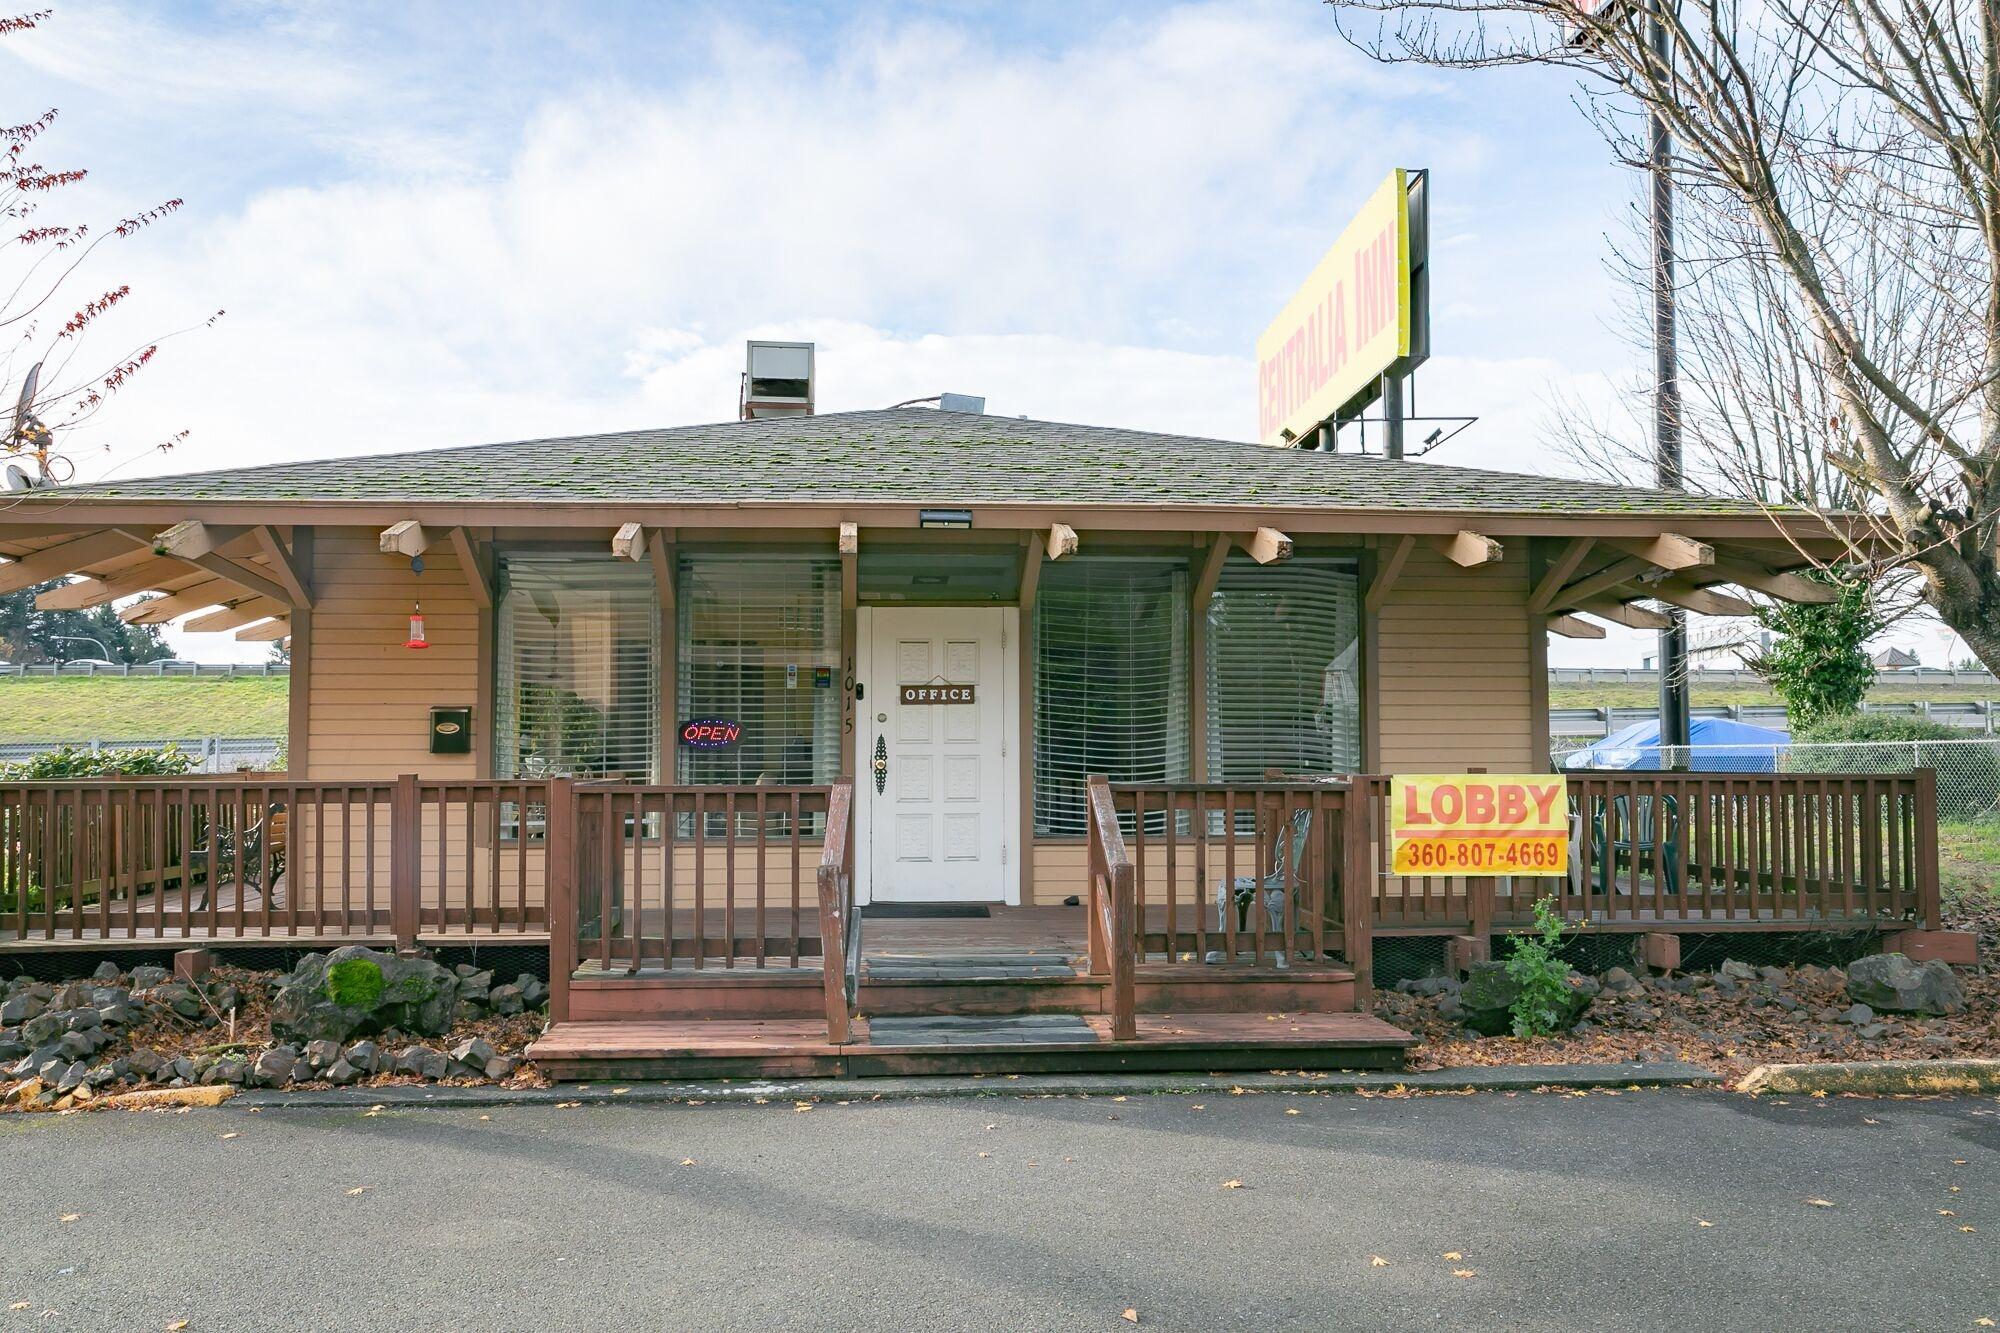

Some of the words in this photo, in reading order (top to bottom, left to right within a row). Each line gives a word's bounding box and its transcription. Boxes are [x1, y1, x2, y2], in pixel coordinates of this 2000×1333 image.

[1259, 280, 1347, 442] CENTRALIA
[1355, 219, 1396, 353] INN
[844, 656, 854, 734] 1015
[905, 689, 971, 700] OFFICE
[684, 726, 740, 741] OPEN
[1405, 784, 1561, 825] LOBBY
[1408, 843, 1559, 867] 360-807-4669
